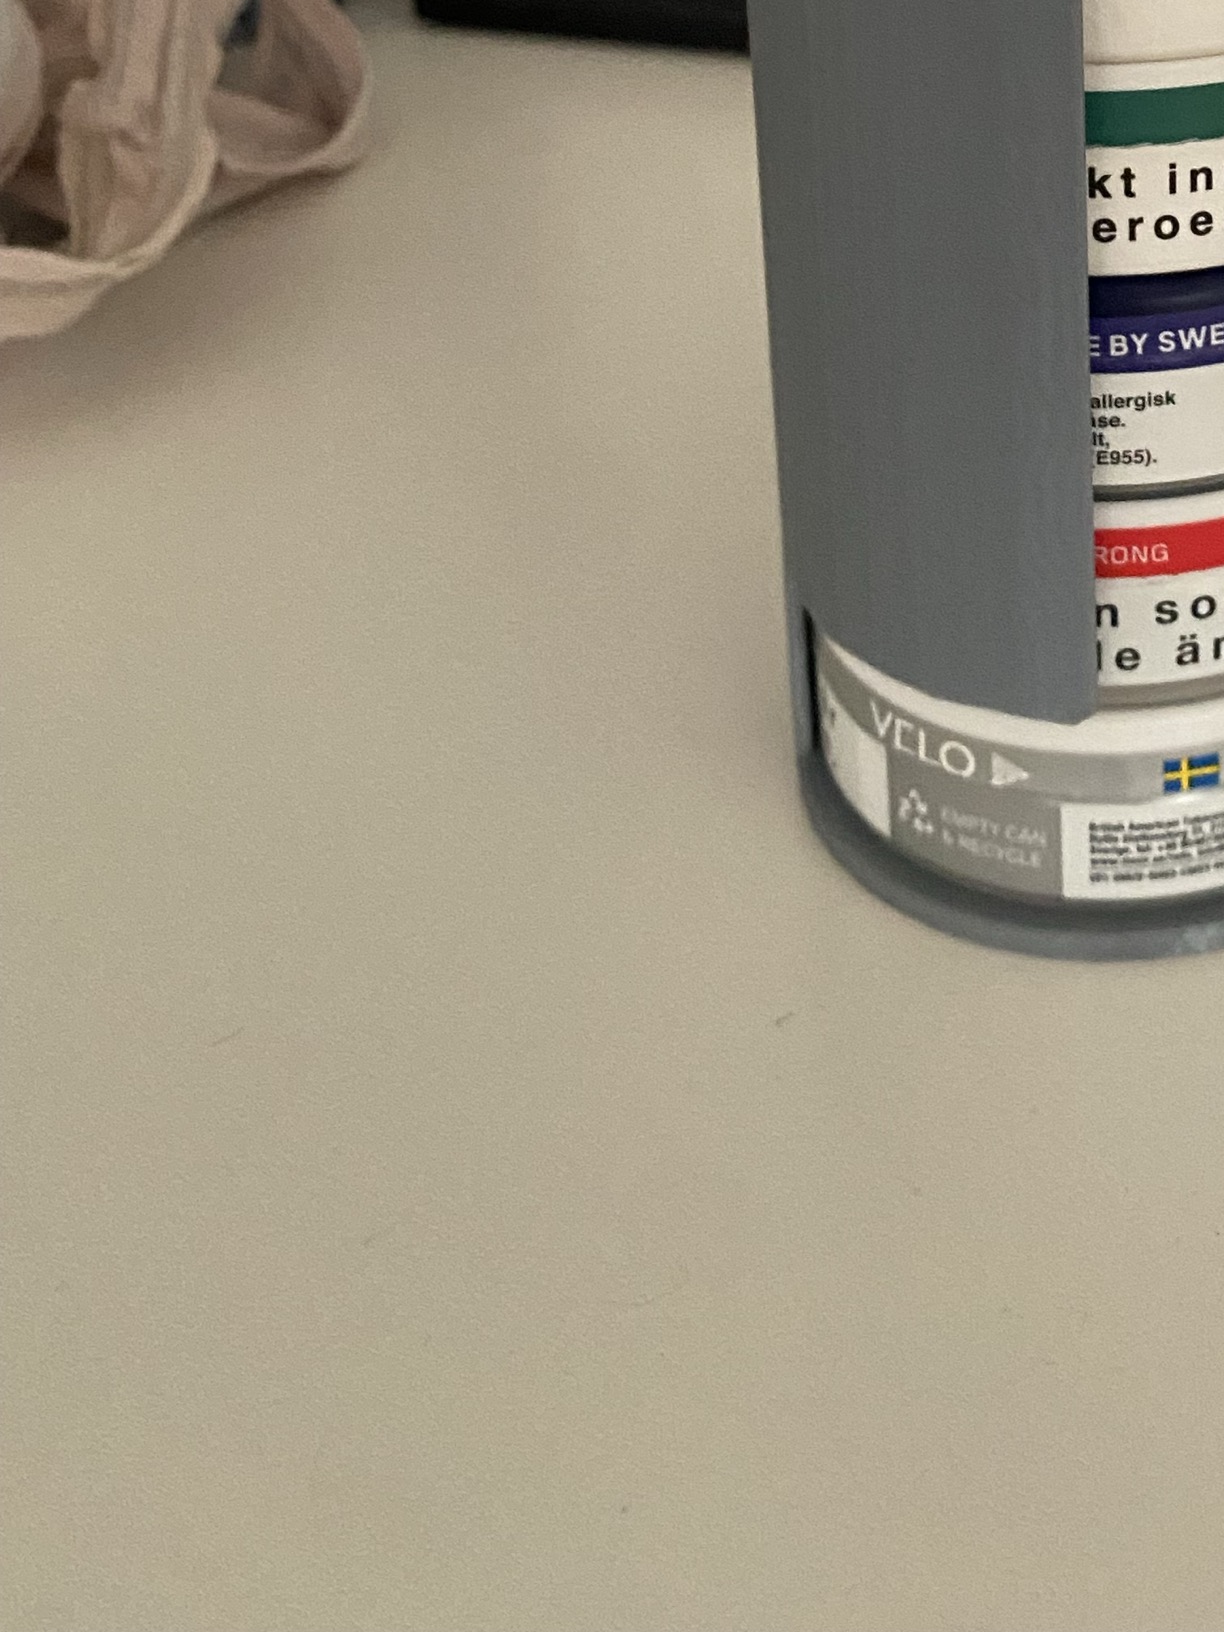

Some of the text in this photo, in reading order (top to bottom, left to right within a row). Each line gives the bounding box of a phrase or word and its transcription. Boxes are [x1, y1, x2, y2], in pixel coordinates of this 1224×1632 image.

[1087, 166, 1137, 199] kt
[1109, 333, 1149, 357] BY
[1090, 390, 1176, 412] allergisk
[1096, 448, 1158, 468] E955).
[869, 698, 976, 779] VELO
